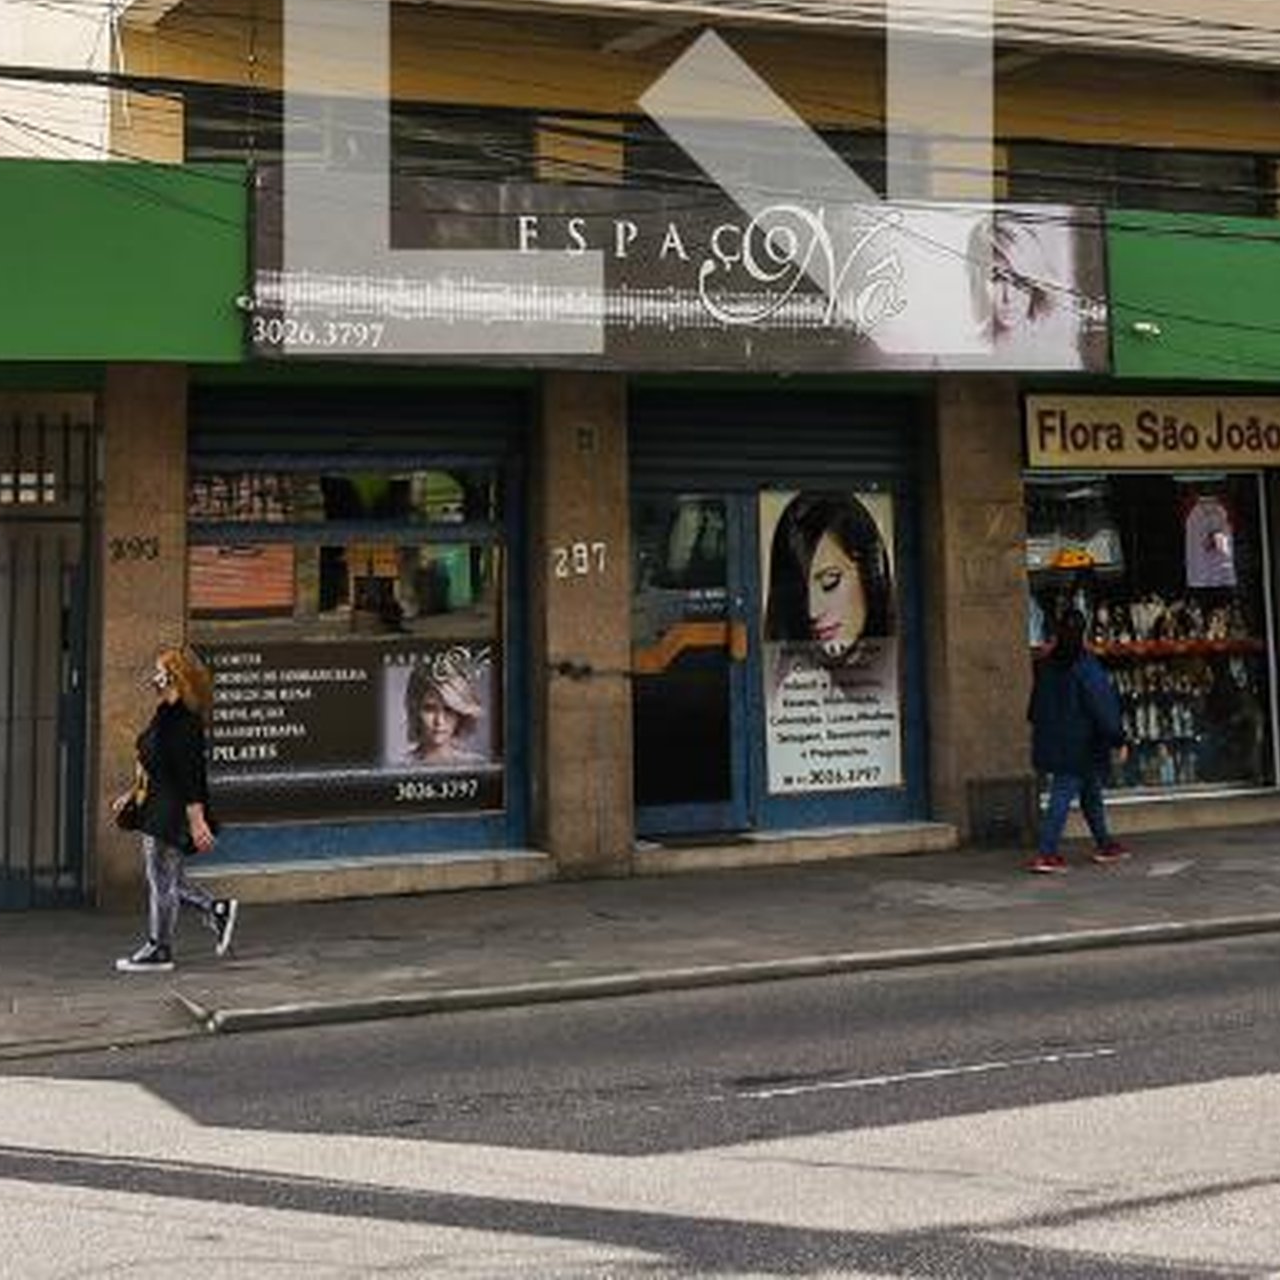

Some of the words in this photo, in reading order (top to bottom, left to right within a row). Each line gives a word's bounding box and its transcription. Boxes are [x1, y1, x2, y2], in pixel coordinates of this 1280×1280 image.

[517, 215, 798, 272] ESPAÇO
[251, 316, 384, 348] 3026.3797
[1037, 408, 1124, 452] Flora
[1136, 409, 1200, 452] São
[213, 742, 278, 762] PILATES
